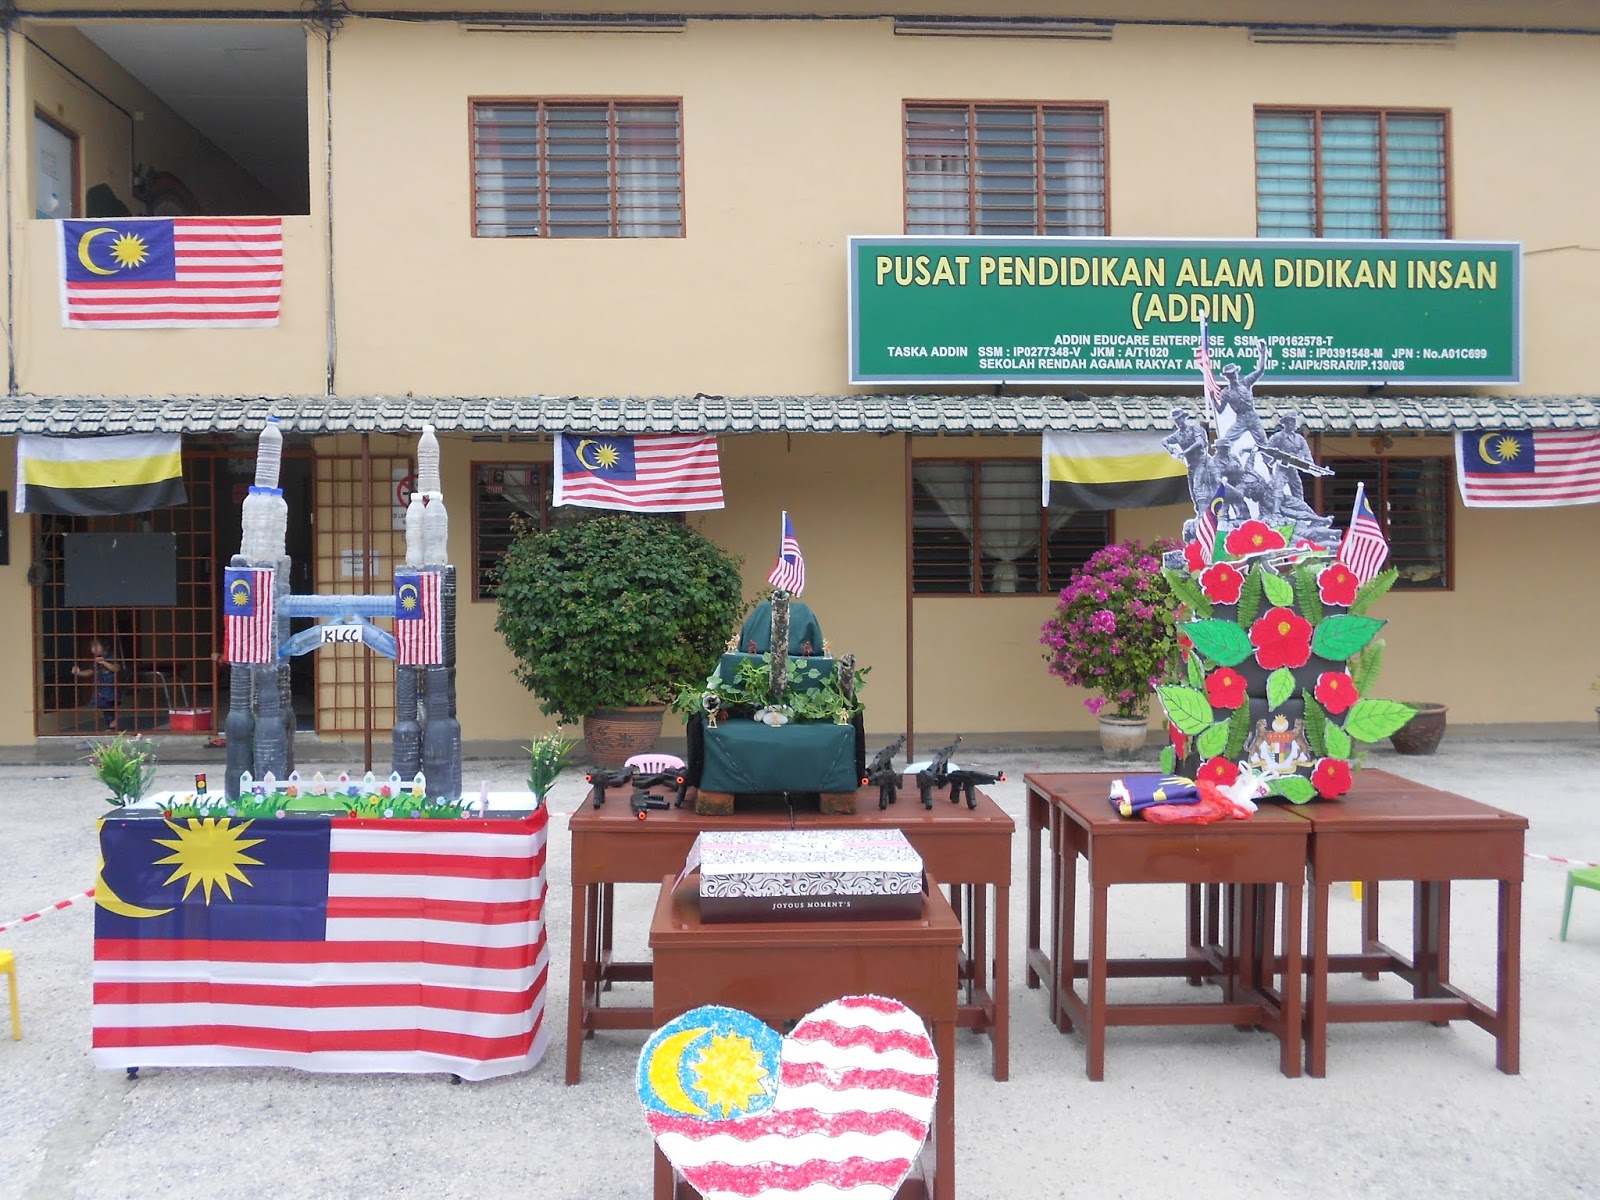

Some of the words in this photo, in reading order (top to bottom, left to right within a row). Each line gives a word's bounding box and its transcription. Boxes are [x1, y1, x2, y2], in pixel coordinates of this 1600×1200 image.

[876, 255, 970, 286] PUSAT
[980, 256, 1165, 287] PENDIDIKAN
[1175, 258, 1264, 287] ALAM
[1274, 258, 1397, 289] DIDIKAN
[1407, 260, 1497, 290] INSAN
[1131, 292, 1255, 330] (ADDIN)
[1054, 335, 1090, 345] ADDIN
[1094, 335, 1149, 346] EDUCARE
[1153, 335, 1225, 347] ENTERPSE
[1268, 336, 1333, 346] IP0162578-T
[887, 347, 928, 357] TASKA
[931, 347, 968, 357] ADDIN
[978, 347, 1003, 357] SSM
[1013, 347, 1081, 357] IP0277348-V
[1090, 347, 1115, 357] JKM
[1125, 347, 1169, 357] A/T1020
[1191, 348, 1234, 358] TDIKA
[1237, 348, 1273, 358] ADDN
[1281, 348, 1306, 358] SSM
[1316, 348, 1383, 358] IP0391548-M
[1391, 349, 1413, 359] JPN
[1423, 349, 1487, 359] No.A01C699
[979, 359, 1035, 369] SEKOLAH
[1039, 359, 1086, 369] RENDAH
[1090, 359, 1132, 369] AGAMA
[1136, 359, 1182, 369] RAKYAT
[324, 629, 359, 643] KLCC
[772, 902, 804, 910] JOYOUS
